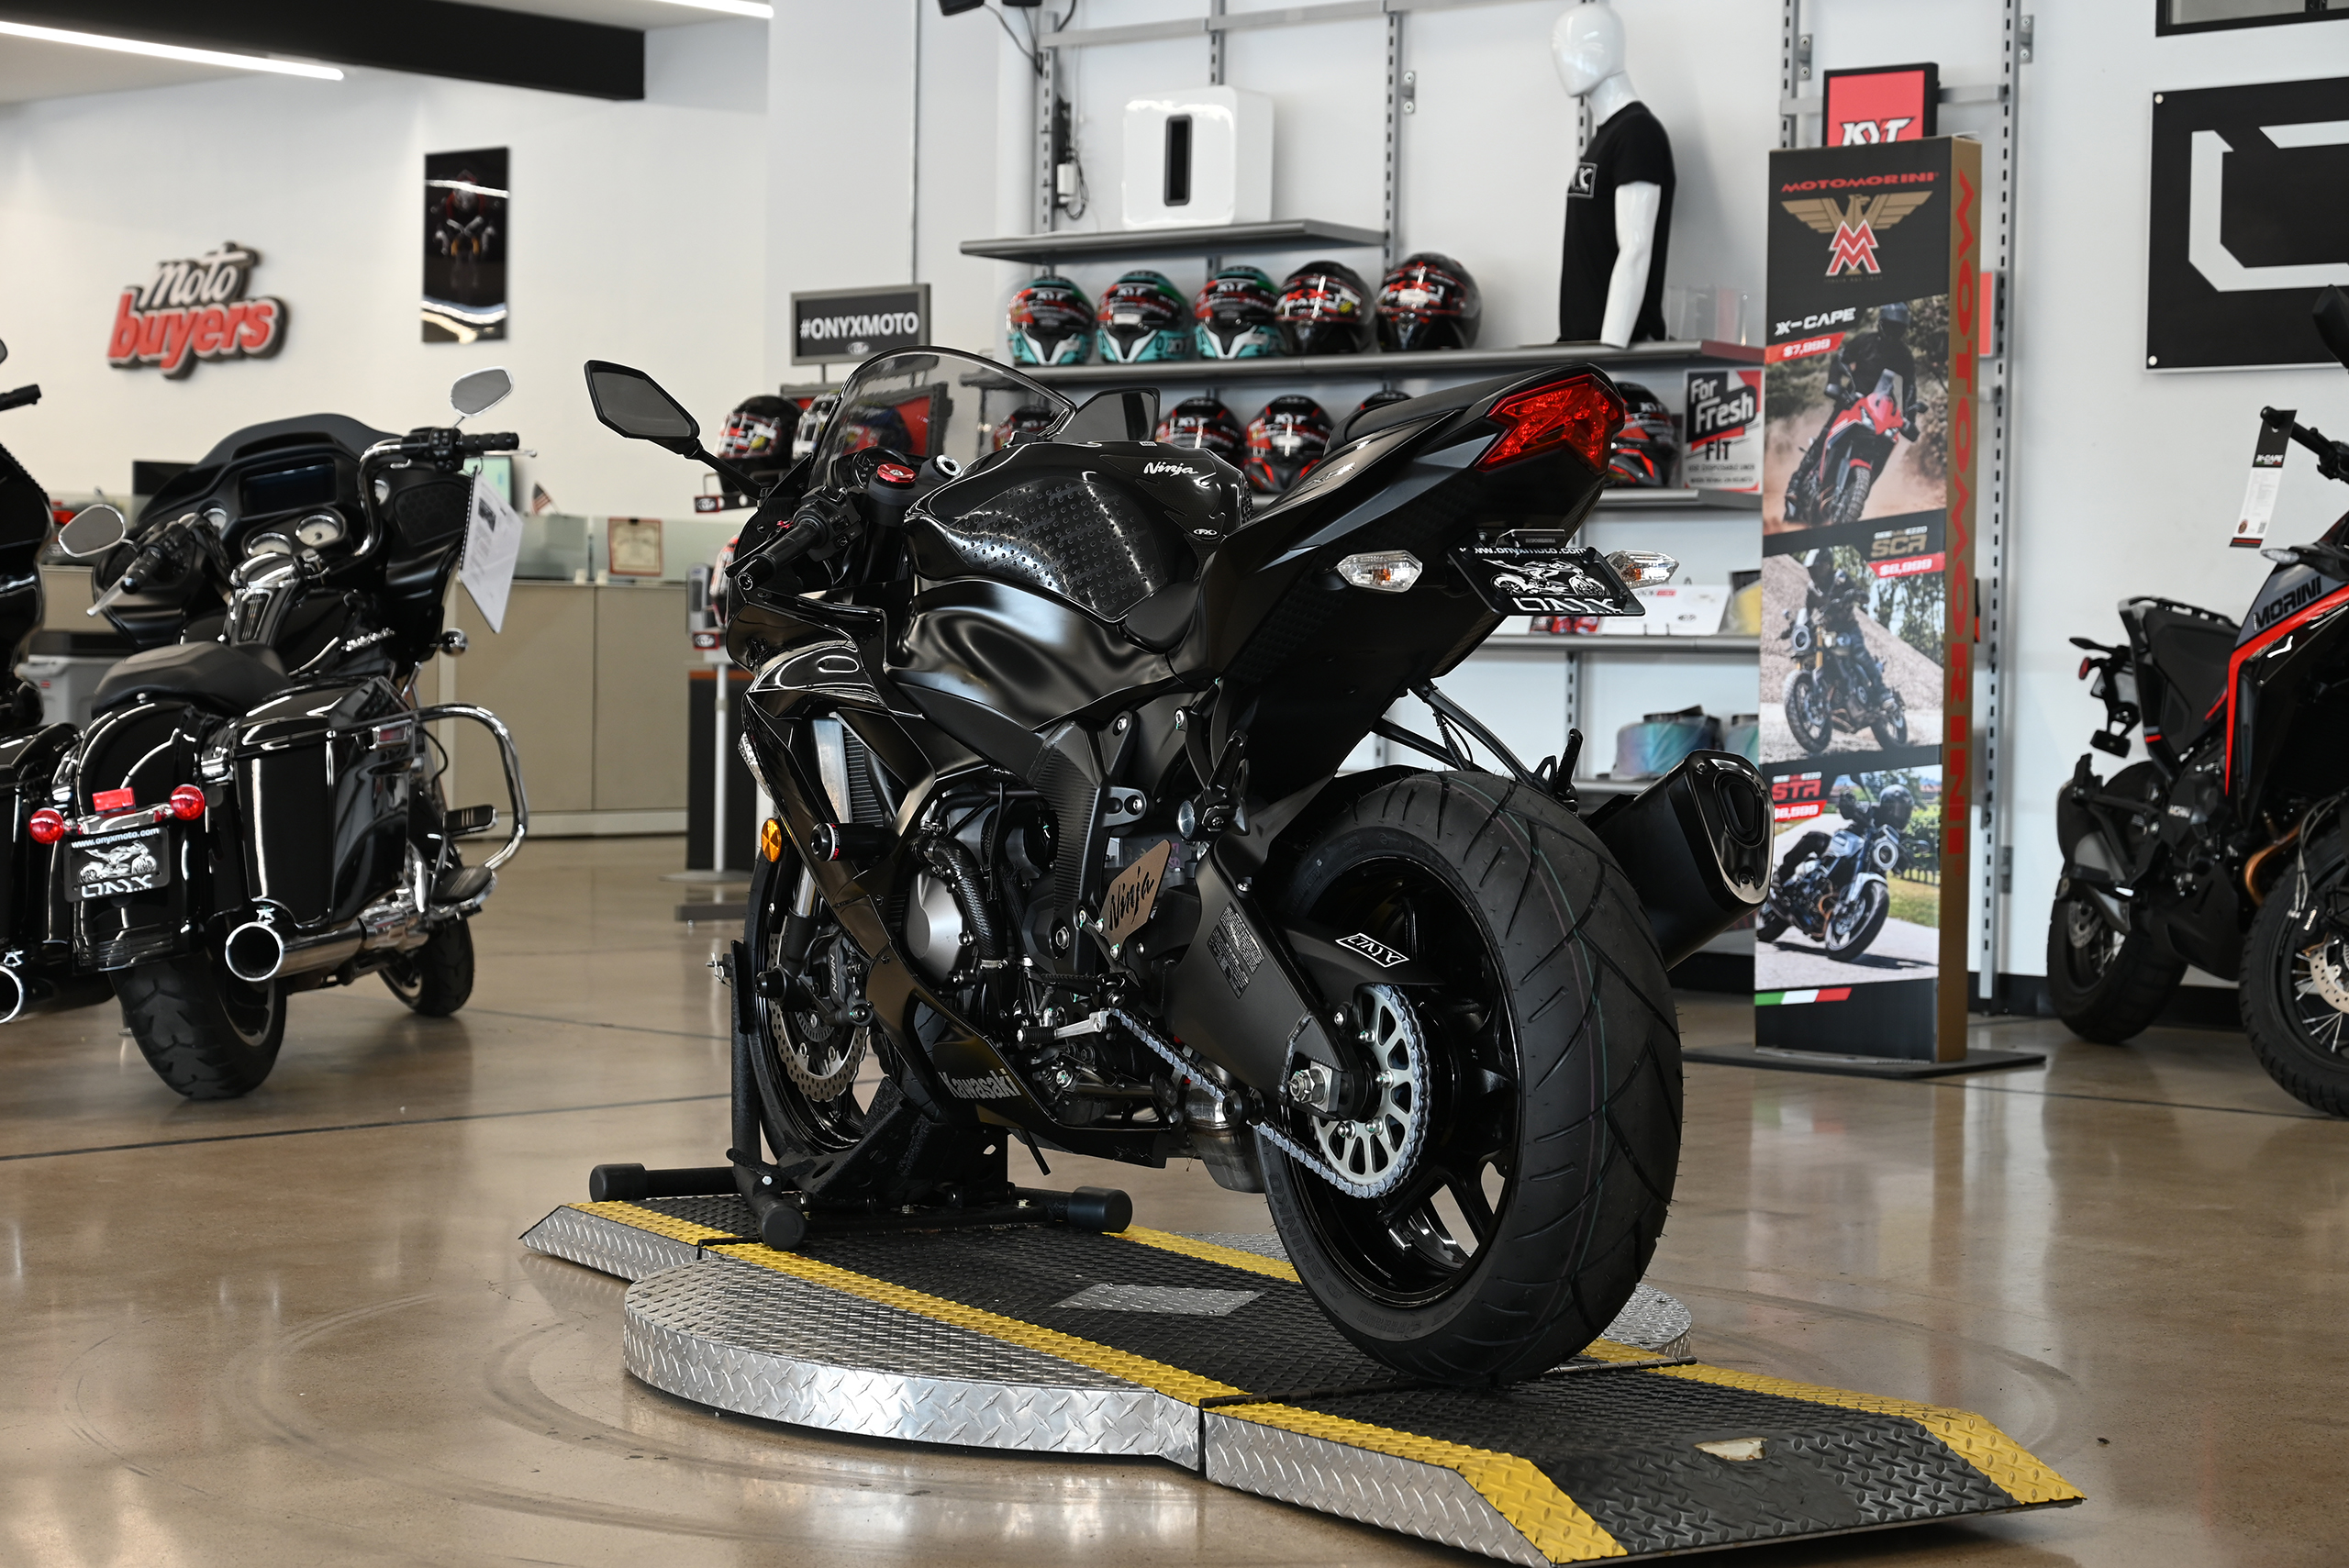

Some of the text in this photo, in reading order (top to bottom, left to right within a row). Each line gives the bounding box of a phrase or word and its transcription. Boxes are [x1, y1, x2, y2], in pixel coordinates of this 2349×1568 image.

[1841, 117, 1915, 147] KYT
[107, 288, 277, 373] buyers
[799, 312, 918, 339] #ONYXMOTO
[1775, 307, 1856, 336] X-CAPE
[1690, 377, 1719, 404] For
[1695, 391, 1754, 434] Fresh
[1705, 439, 1732, 461] FIT
[1143, 462, 1199, 477] Ninja
[2256, 575, 2322, 628] MORINI
[72, 828, 159, 849] www.onyxmoto.com
[1108, 865, 1155, 931] Ninja
[938, 1067, 1022, 1099] Kawasaki
